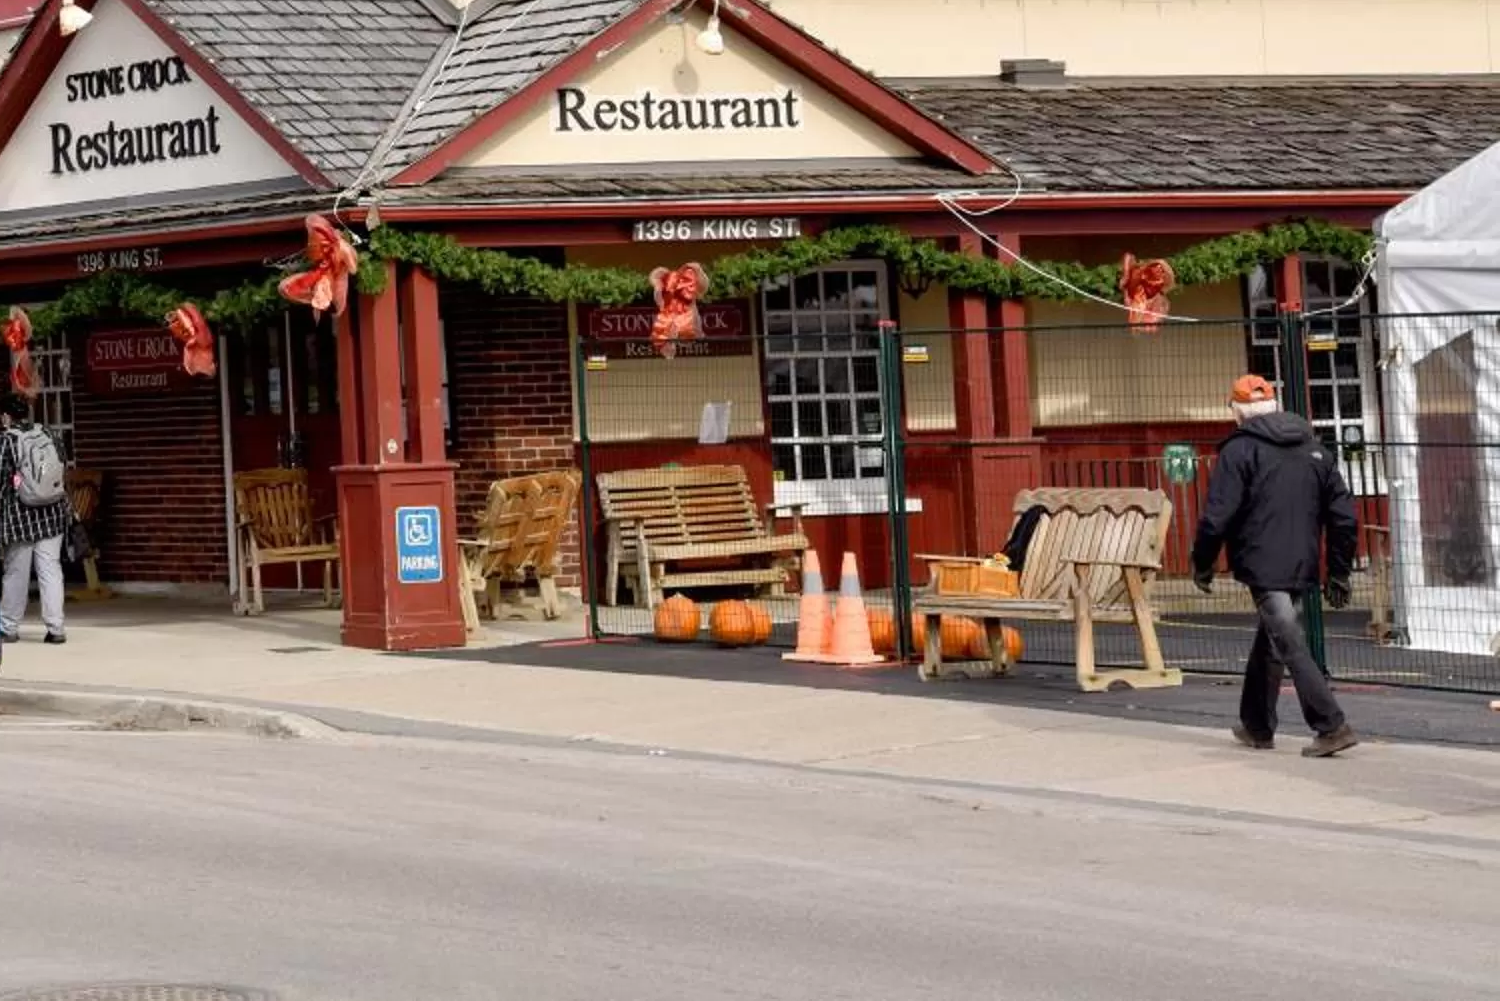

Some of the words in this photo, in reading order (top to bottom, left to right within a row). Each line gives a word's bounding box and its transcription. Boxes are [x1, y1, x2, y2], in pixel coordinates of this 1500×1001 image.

[65, 65, 125, 103] STONE
[127, 54, 192, 92] CROCK
[555, 87, 800, 132] Restaurant
[48, 104, 221, 175] Restaurant
[633, 220, 691, 242] 1396
[703, 219, 758, 240] KING
[768, 217, 801, 239] ST.
[109, 248, 139, 270] KING
[143, 246, 164, 267] ST.
[601, 313, 652, 333] STON
[94, 338, 135, 361] STONE
[136, 335, 180, 360] CROCK
[109, 370, 169, 391] Restaurant
[401, 554, 438, 572] PARKING
